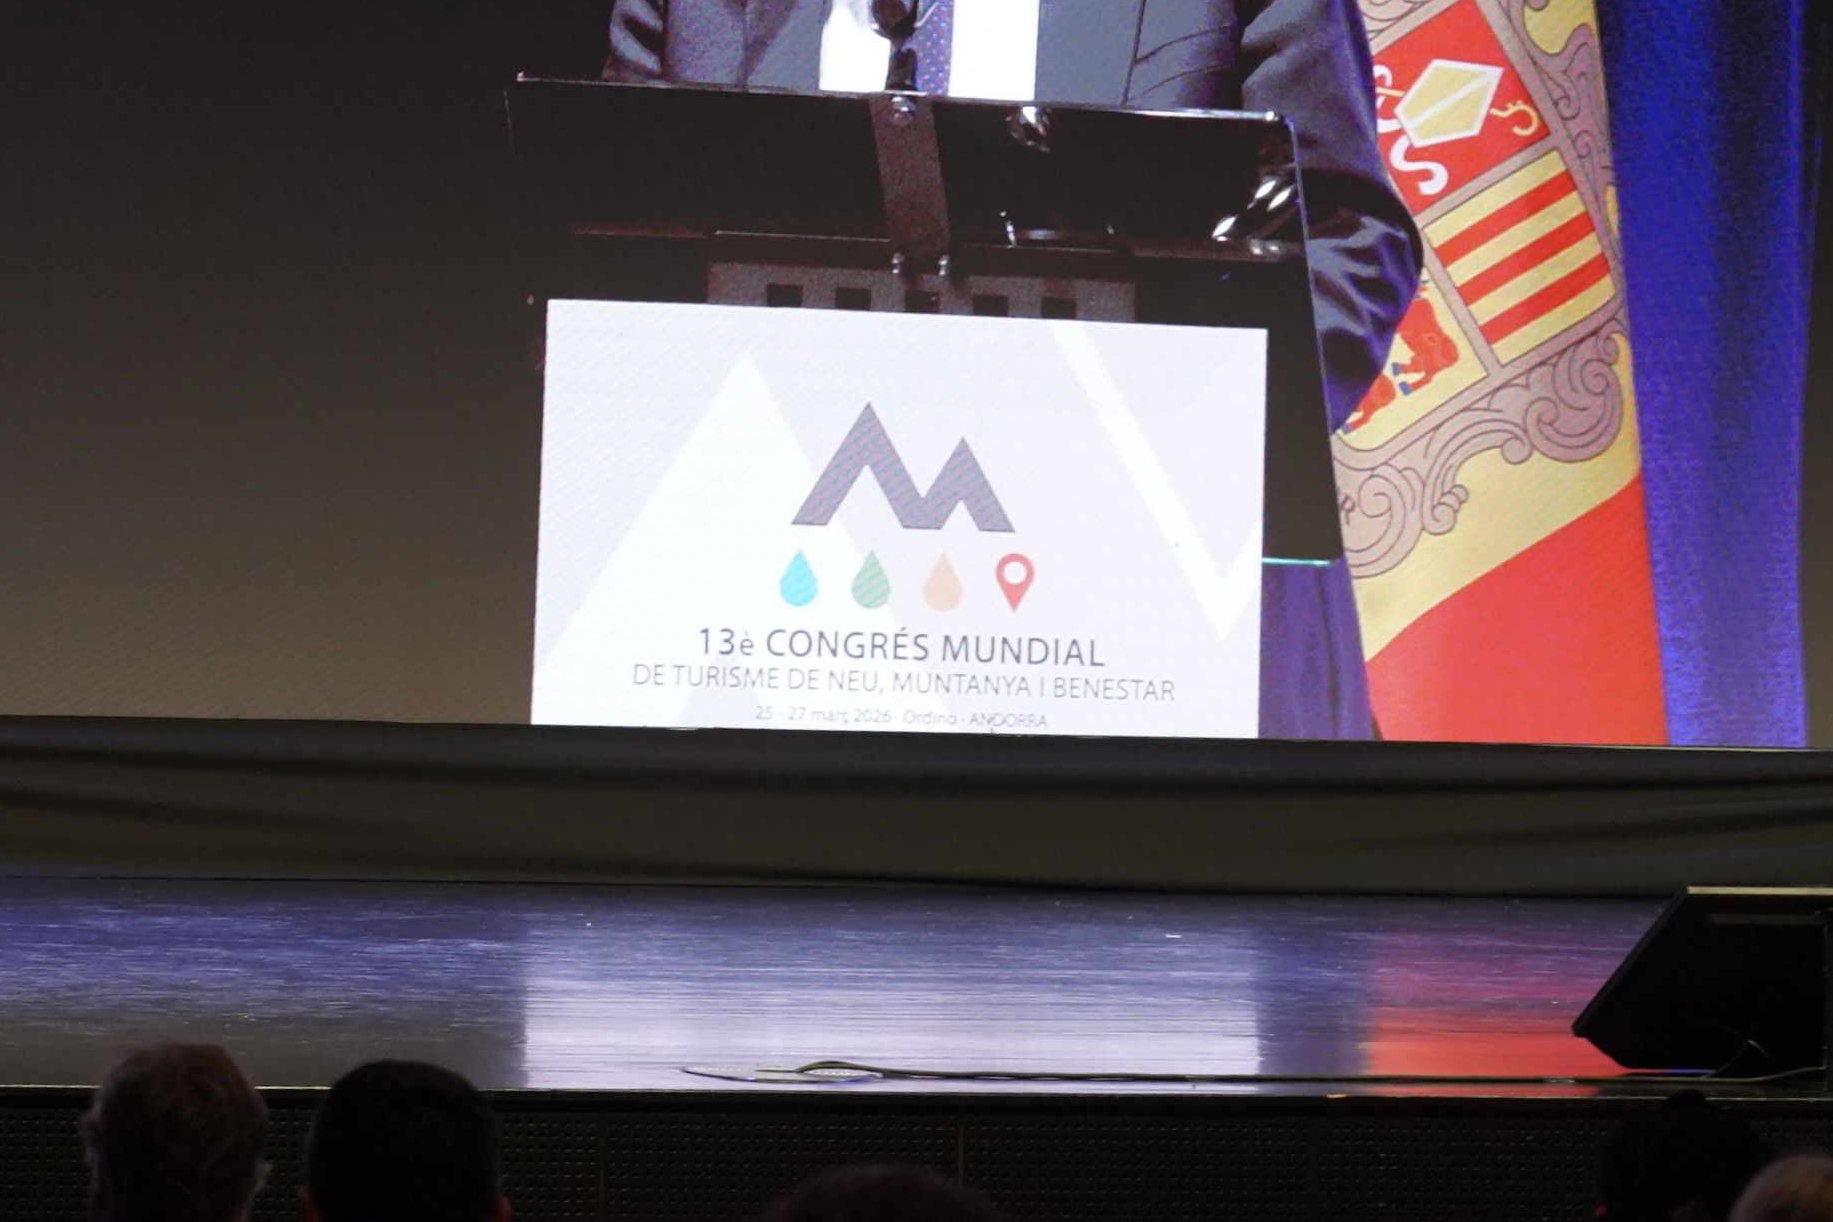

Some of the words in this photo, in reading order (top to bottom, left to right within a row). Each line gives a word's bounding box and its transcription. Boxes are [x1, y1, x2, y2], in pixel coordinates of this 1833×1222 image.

[699, 627, 754, 656] 13è
[766, 626, 929, 661] CONGRÉS
[941, 634, 1105, 667] MUNDIAL
[633, 663, 665, 687] DE
[672, 664, 779, 689] TURISME
[788, 668, 820, 690] DE
[828, 669, 884, 695] NEU,
[892, 671, 1031, 698] MUNTANYA
[1053, 677, 1176, 702] BENESTAR
[787, 705, 807, 721] 27
[853, 708, 893, 725] 2026
[902, 709, 958, 726] Ordino
[968, 712, 1049, 729] ANDORRA
